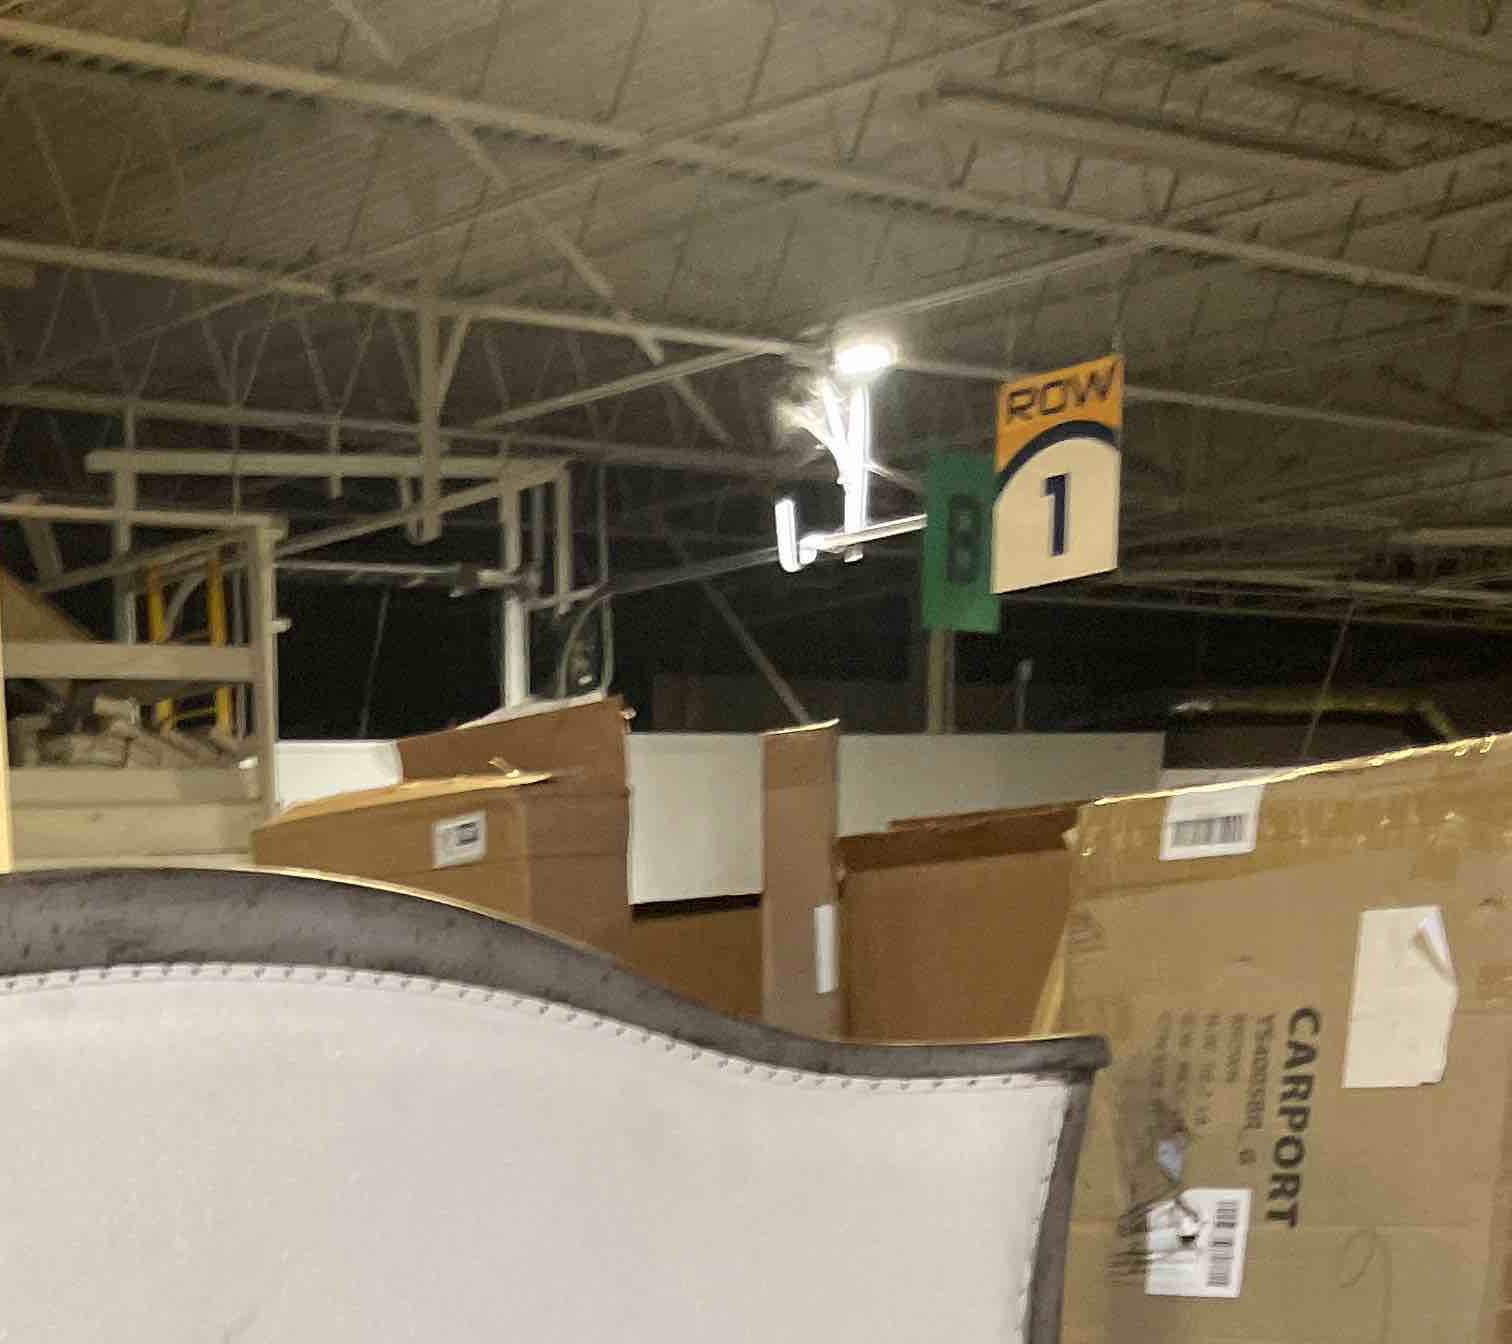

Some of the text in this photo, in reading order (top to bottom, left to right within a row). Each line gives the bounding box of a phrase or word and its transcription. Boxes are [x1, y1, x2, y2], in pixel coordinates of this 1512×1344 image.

[1006, 362, 1116, 424] ROW
[1043, 473, 1069, 556] 1
[1266, 1007, 1321, 1229] CARPORT
